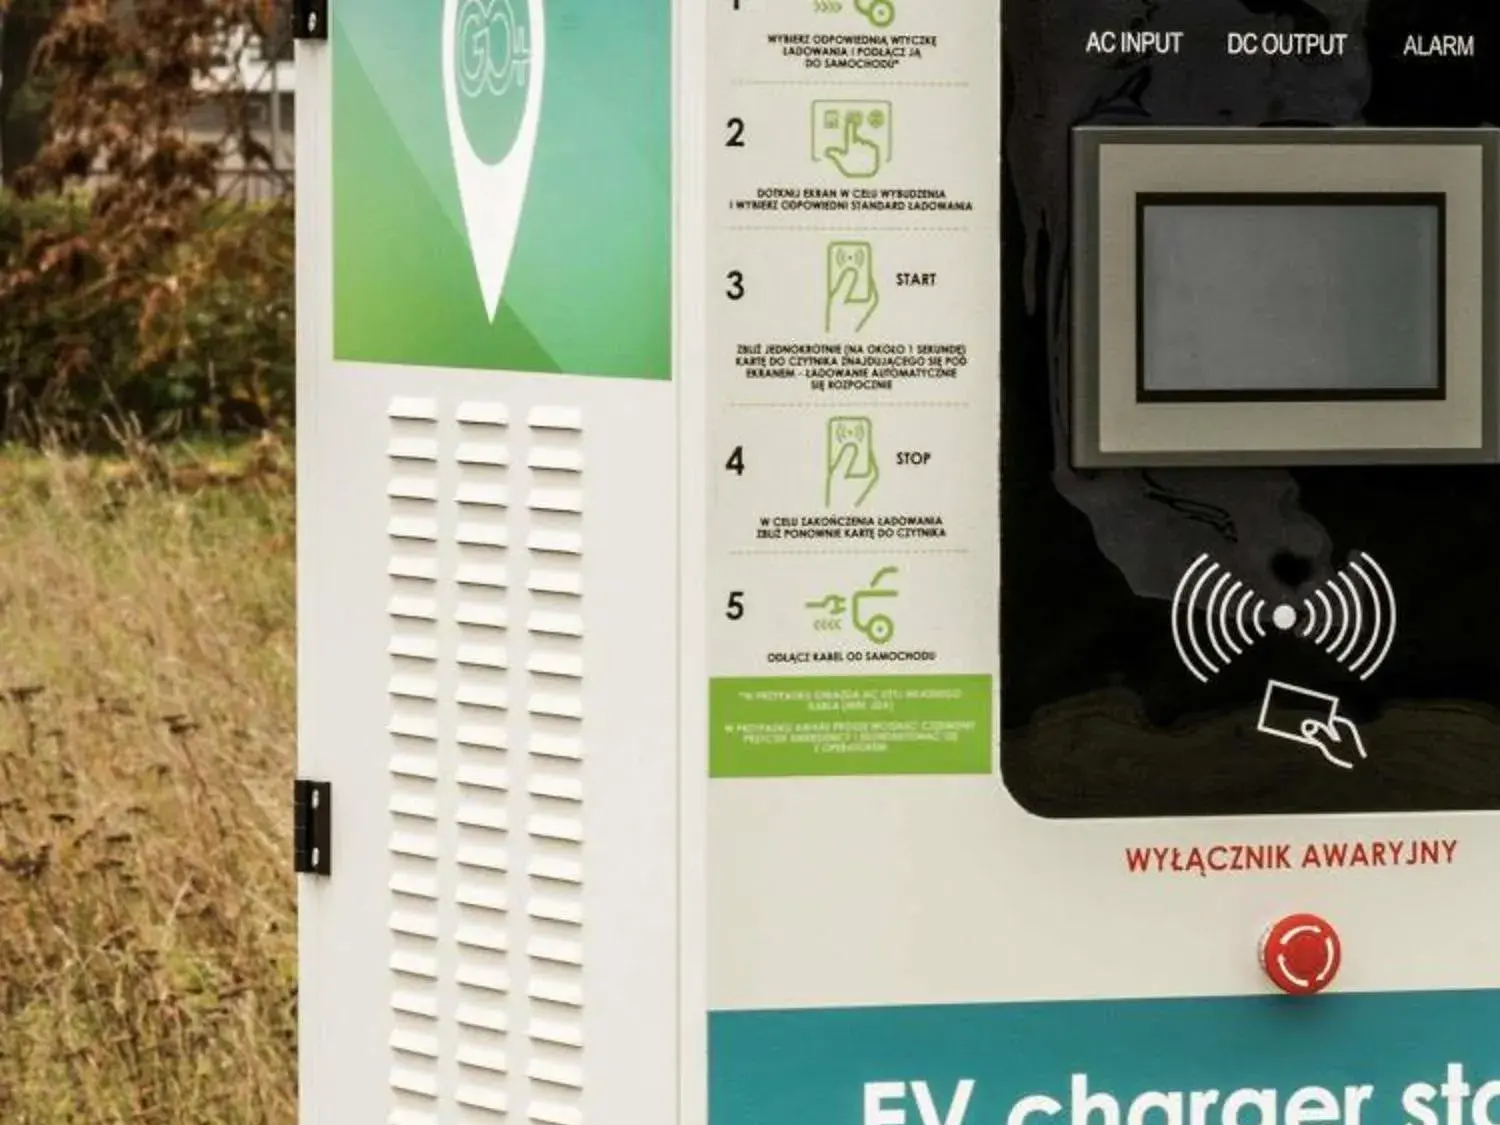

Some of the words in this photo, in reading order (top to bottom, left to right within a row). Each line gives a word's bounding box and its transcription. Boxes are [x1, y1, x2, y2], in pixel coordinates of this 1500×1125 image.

[767, 34, 810, 44] WYBIERZ
[813, 35, 889, 46] ODPOWIEDNIĄ
[891, 35, 938, 47] WTYCZKĘ
[1086, 31, 1116, 54] AC
[1121, 31, 1184, 54] INPUT
[1227, 32, 1259, 55] DC
[1261, 32, 1348, 56] OUTPUT
[1403, 34, 1475, 57] ALARM
[458, 0, 532, 97] GO+
[783, 47, 847, 57] ŁADOWANIA
[857, 47, 905, 58] PODŁĄCZ
[805, 59, 821, 68] DO
[725, 117, 746, 148] 2
[803, 189, 837, 199] EKRAN
[840, 189, 849, 198] W
[852, 189, 878, 198] CELU
[736, 201, 778, 210] WYBIERZ
[781, 201, 849, 211] ODPOWIEDNI
[851, 201, 905, 210] STANDARD
[725, 269, 745, 301] 3
[896, 273, 937, 287] START
[736, 356, 766, 368] KARTĘ
[769, 356, 785, 366] DO
[788, 356, 838, 367] CZYTNIKA
[841, 356, 925, 368] ZNAJDUJĄCEGO
[929, 356, 944, 367] SIĘ
[746, 369, 795, 379] EKRANEM
[805, 368, 868, 379] ŁADOWANIE
[872, 367, 957, 378] AUTOMATYCZNIE
[828, 379, 892, 390] ROZPOCZNIE
[725, 446, 745, 475] 4
[896, 451, 932, 465] STOP
[760, 517, 770, 527] W
[773, 517, 798, 527] CELU
[800, 515, 874, 527] ZAKOŃCZENIA
[877, 516, 943, 526] ŁADOWANIA
[784, 528, 842, 539] PONOWNIE
[844, 528, 875, 540] KARTĘ
[878, 528, 894, 538] DO
[896, 527, 946, 538] CZYTNIKA
[725, 591, 745, 620] 5
[767, 652, 810, 664] ODŁĄCZ
[813, 652, 843, 662] KABEL
[846, 652, 862, 662] OD
[866, 651, 936, 661] SAMOCHODU
[1125, 844, 1291, 877] WYŁĄCZNIK
[1301, 839, 1458, 869] AWARYJNY
